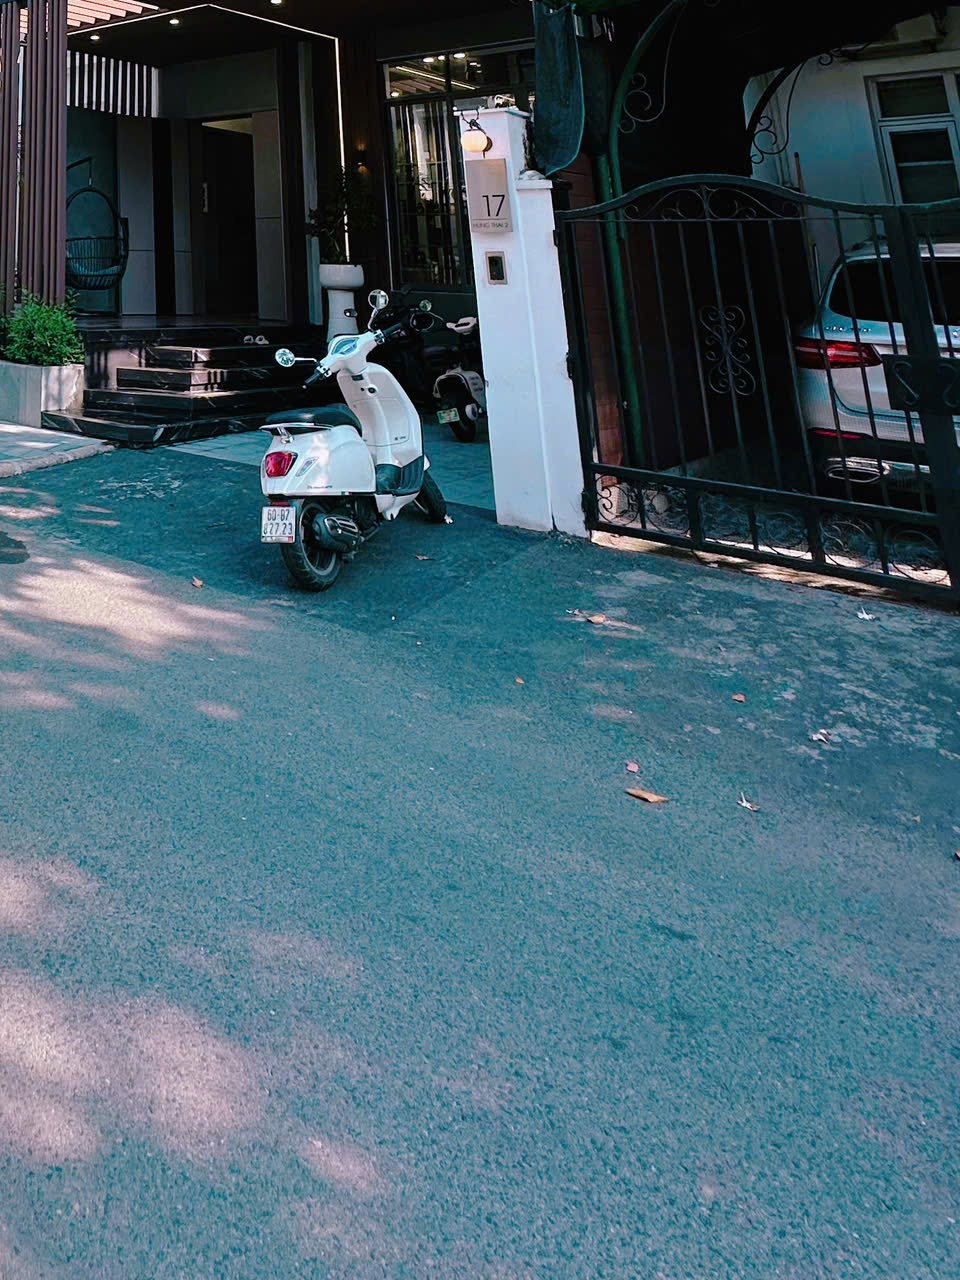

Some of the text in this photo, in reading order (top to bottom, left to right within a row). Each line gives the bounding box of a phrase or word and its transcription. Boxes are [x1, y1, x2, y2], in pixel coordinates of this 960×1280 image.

[482, 194, 506, 217] 17
[267, 508, 290, 522] 60-B7
[263, 522, 293, 535] 827.23
